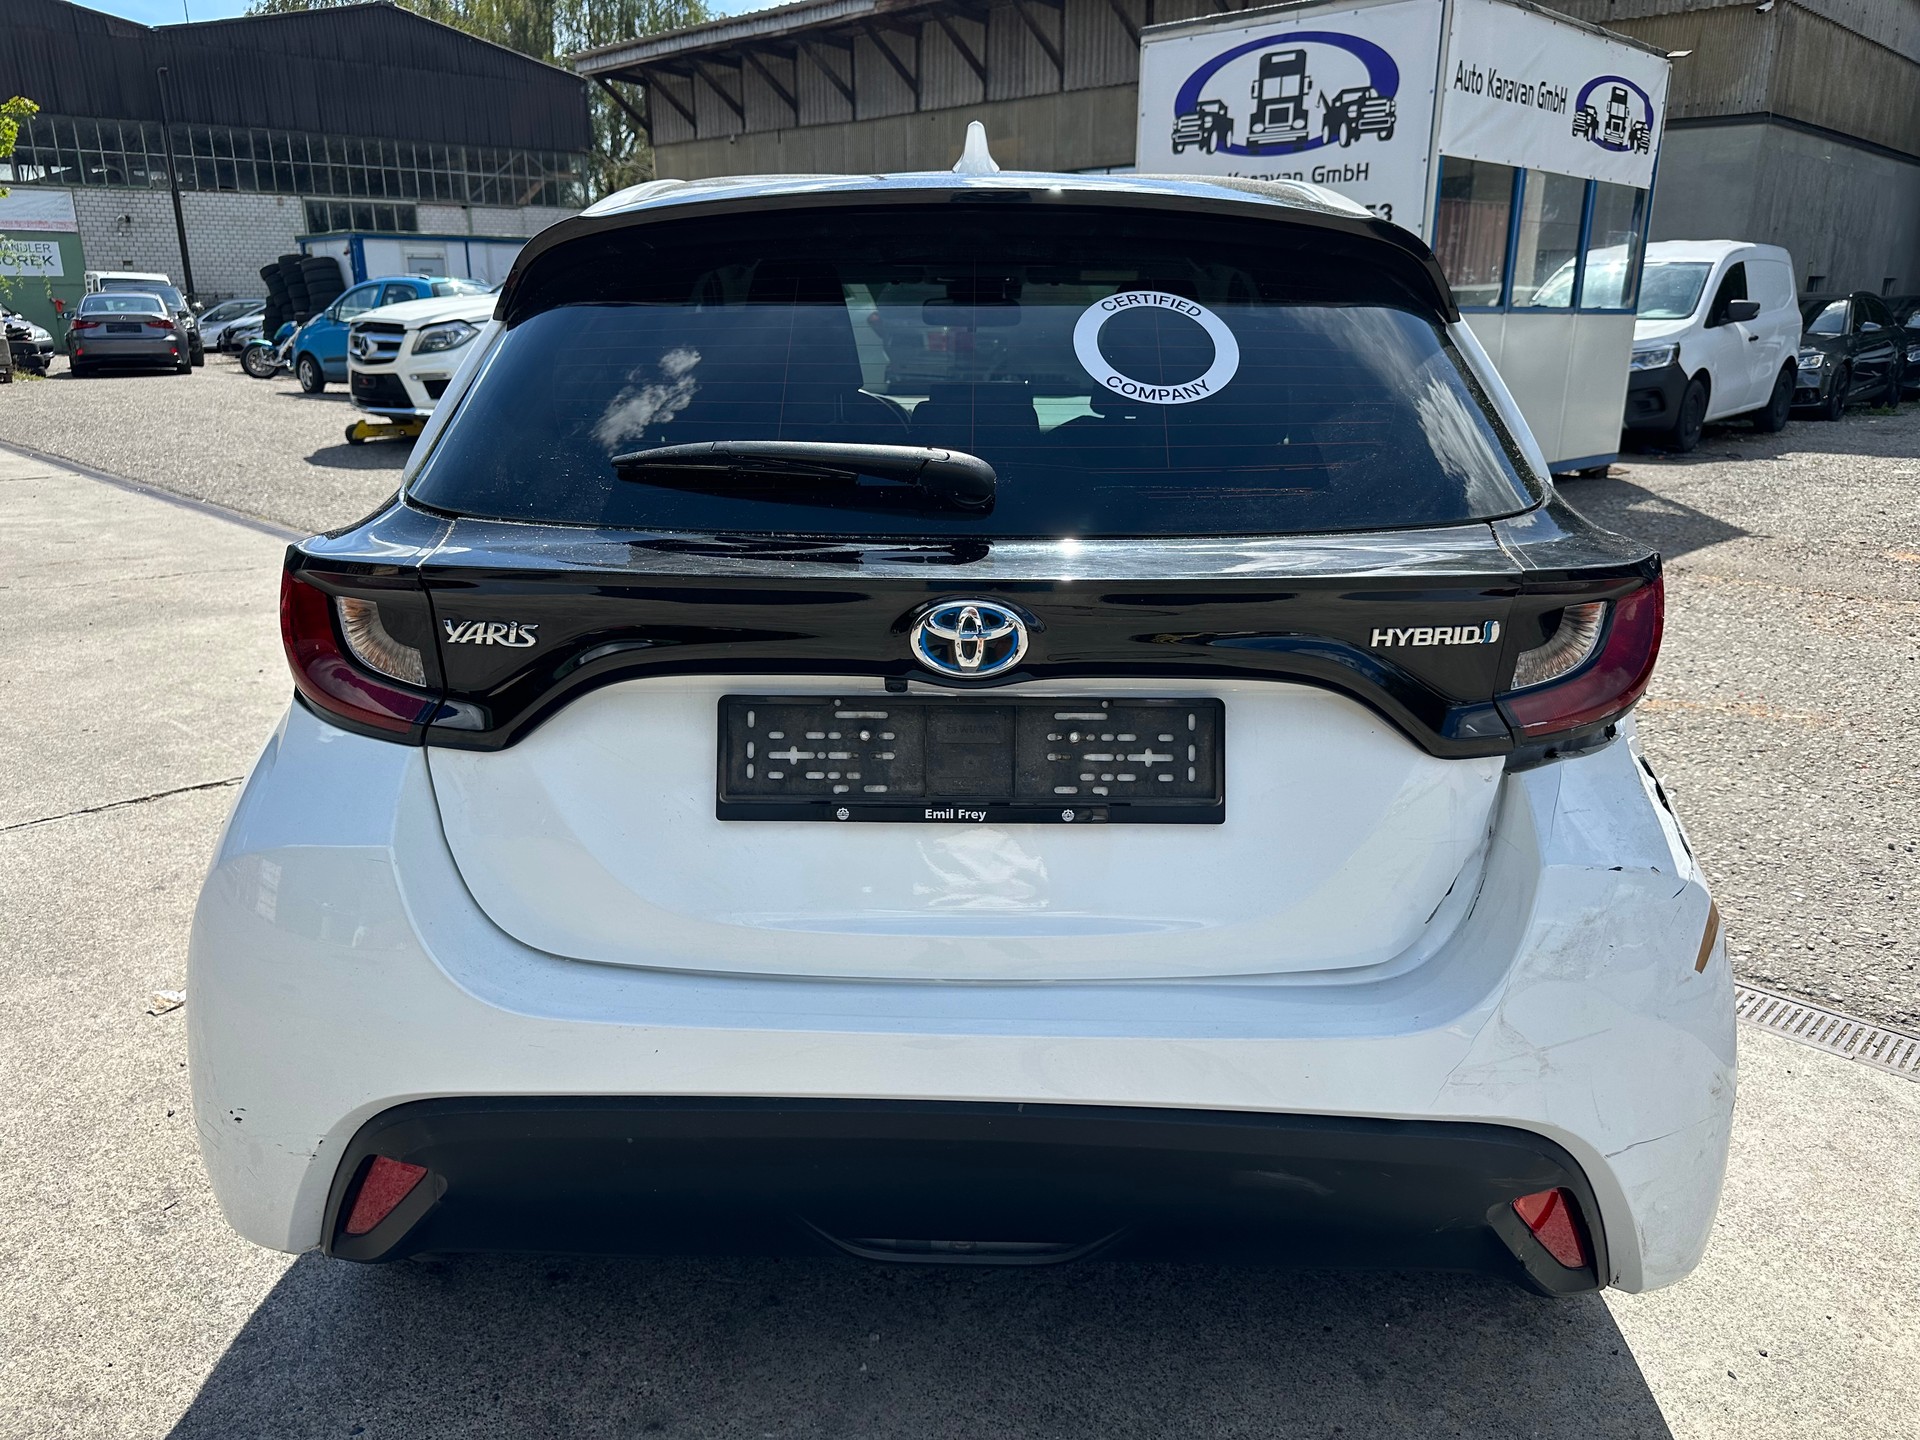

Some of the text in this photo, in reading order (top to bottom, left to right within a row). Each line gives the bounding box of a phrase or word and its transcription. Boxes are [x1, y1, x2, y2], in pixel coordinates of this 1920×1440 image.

[1453, 59, 1568, 115] Auto Karavan GmbH
[1311, 162, 1370, 184] GmbH
[0, 255, 55, 266] OREK
[1101, 293, 1202, 317] CERTIFIED
[1106, 376, 1211, 401] COMPANY
[1370, 625, 1481, 647] HYBRID
[925, 808, 987, 821] Emil Frey
